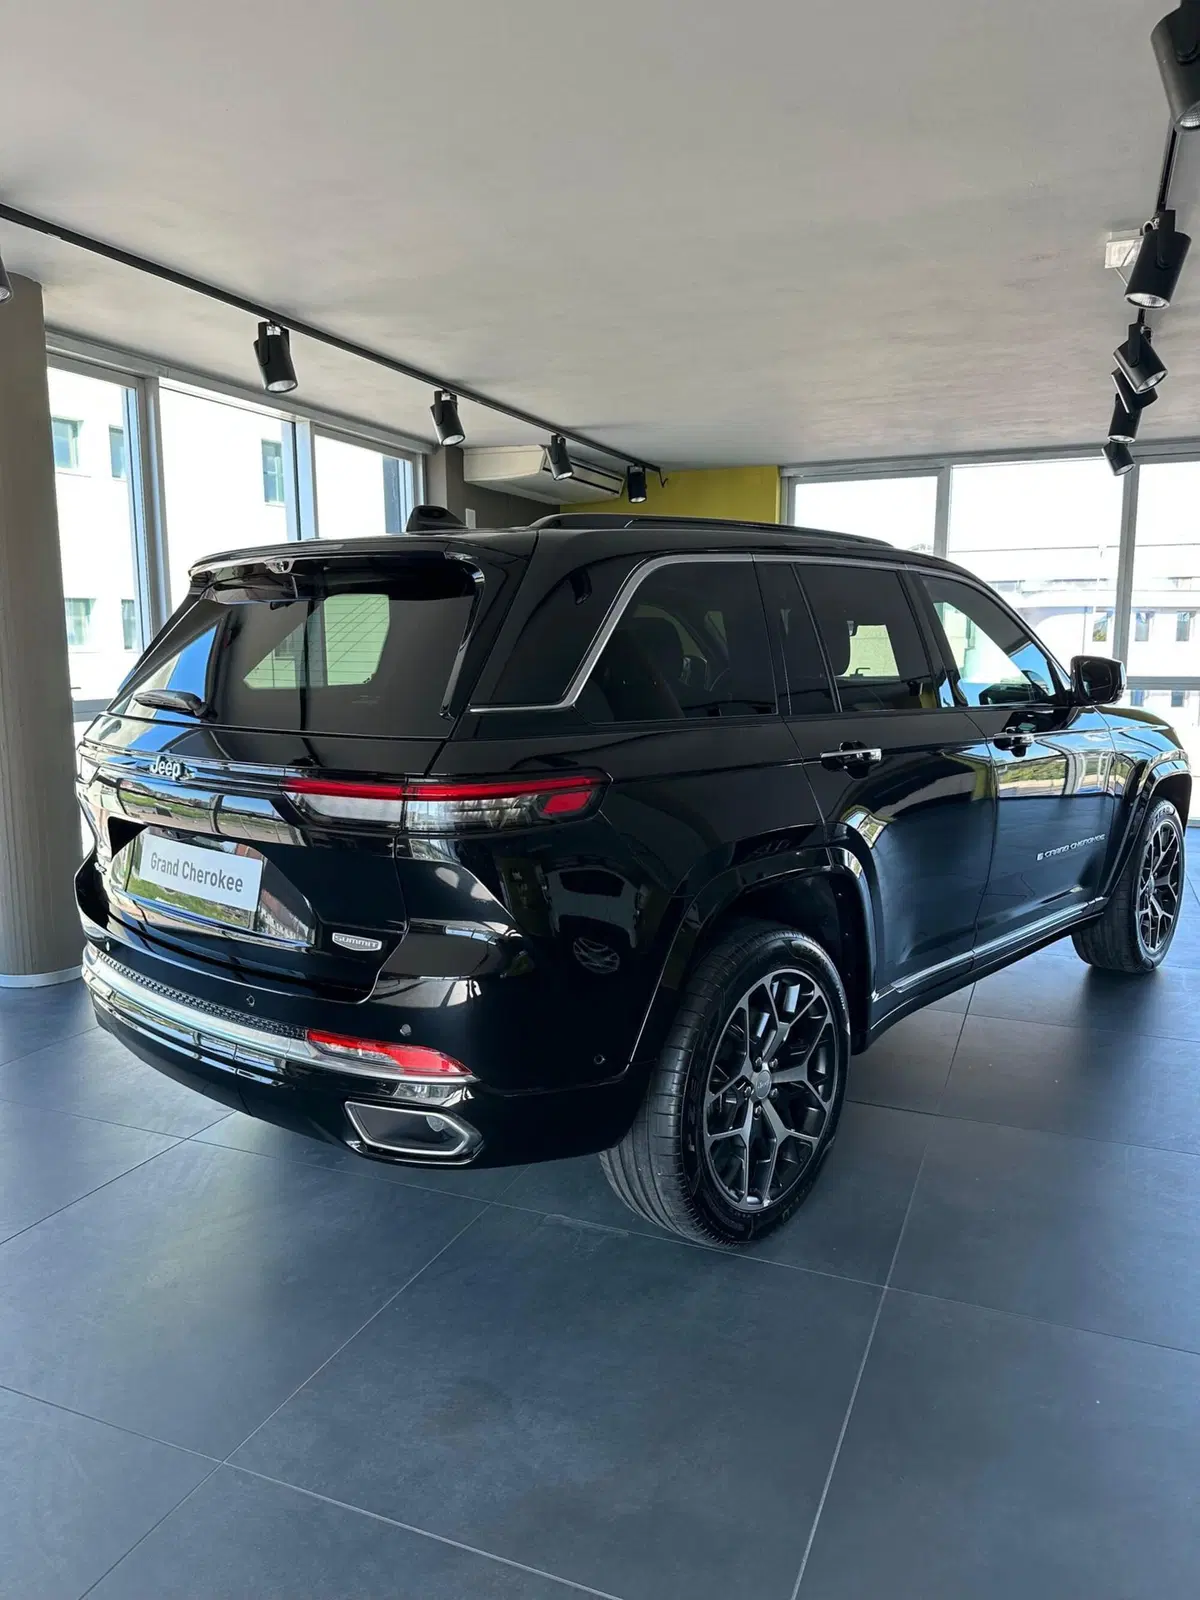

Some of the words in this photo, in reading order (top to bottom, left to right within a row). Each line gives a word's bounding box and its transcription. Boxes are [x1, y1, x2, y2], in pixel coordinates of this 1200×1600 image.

[150, 755, 181, 781] Jeep
[1044, 845, 1069, 858] GRAND
[150, 852, 180, 877] Grand
[182, 861, 244, 893] Cherokee
[334, 935, 378, 948] SUMMIT
